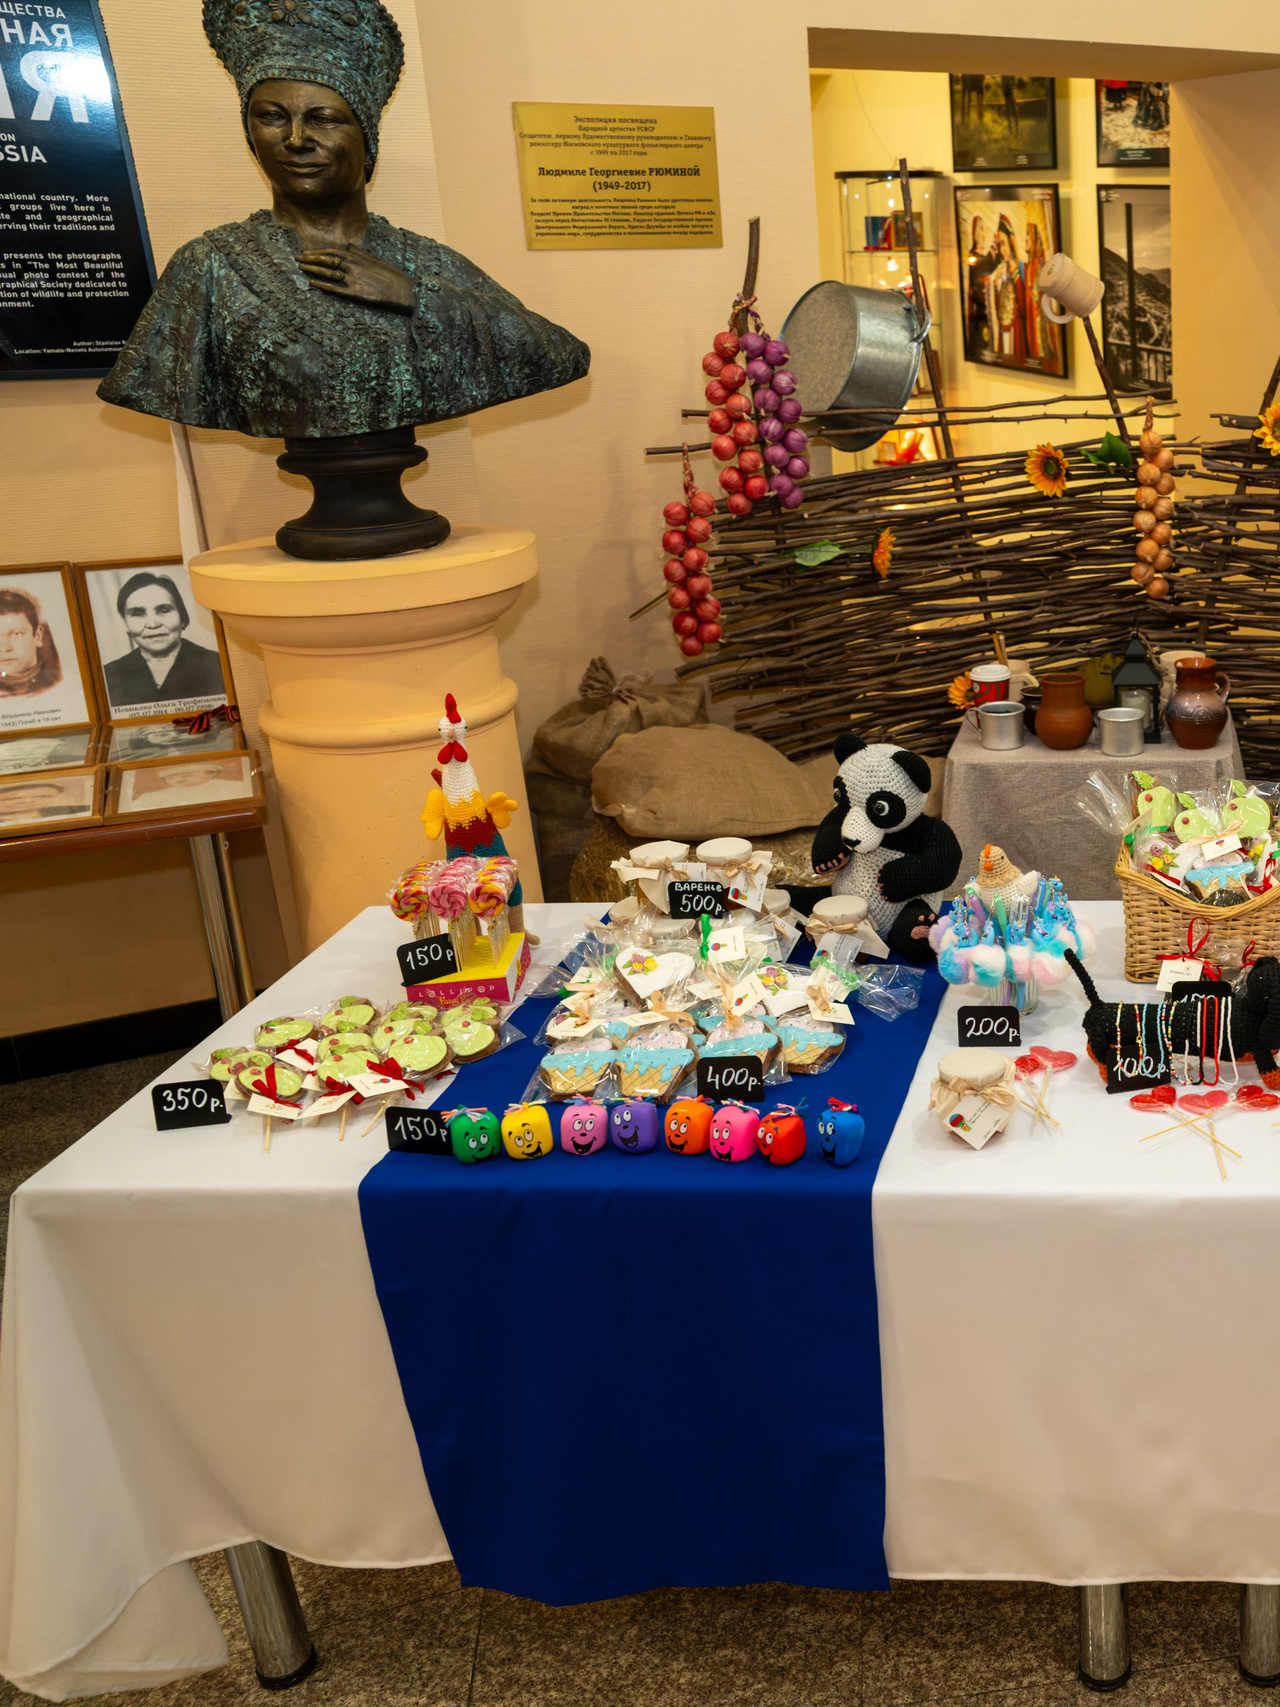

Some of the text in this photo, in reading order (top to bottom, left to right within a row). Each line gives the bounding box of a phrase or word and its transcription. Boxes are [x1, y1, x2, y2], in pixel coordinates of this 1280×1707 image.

[574, 115, 658, 125] Экспозиция посвящена
[578, 125, 656, 134] Народной артистке РСФСР
[582, 133, 636, 142] Художественному
[636, 135, 678, 143] руководителю
[684, 135, 712, 143] Главному
[529, 141, 562, 149] режиссеру
[563, 140, 601, 148] Московского
[602, 142, 640, 150] культурного
[641, 141, 682, 149] фольклорного
[537, 165, 700, 179] Людмиле Георгиевне РЮМИНОЙ
[592, 180, 651, 193] (1949-2017)
[40, 194, 79, 204] country.
[10, 202, 112, 214] groups live here in
[25, 213, 114, 222] and geographical
[29, 222, 51, 231] their
[53, 223, 98, 232] traditions
[3, 252, 122, 263] presents the photographs
[12, 260, 22, 270] in
[56, 260, 78, 270] Most
[84, 260, 124, 270] Beautiful
[24, 268, 126, 281] photo contest of the
[40, 279, 128, 291] Society dedicated to
[20, 288, 30, 298] of
[32, 288, 65, 298] wildlife
[67, 288, 83, 298] and
[85, 288, 130, 299] protection
[113, 696, 227, 714] Новикова Ольга Трофимовна
[1, 708, 62, 720] Владимир Иванович
[18, 718, 36, 726] Погиб
